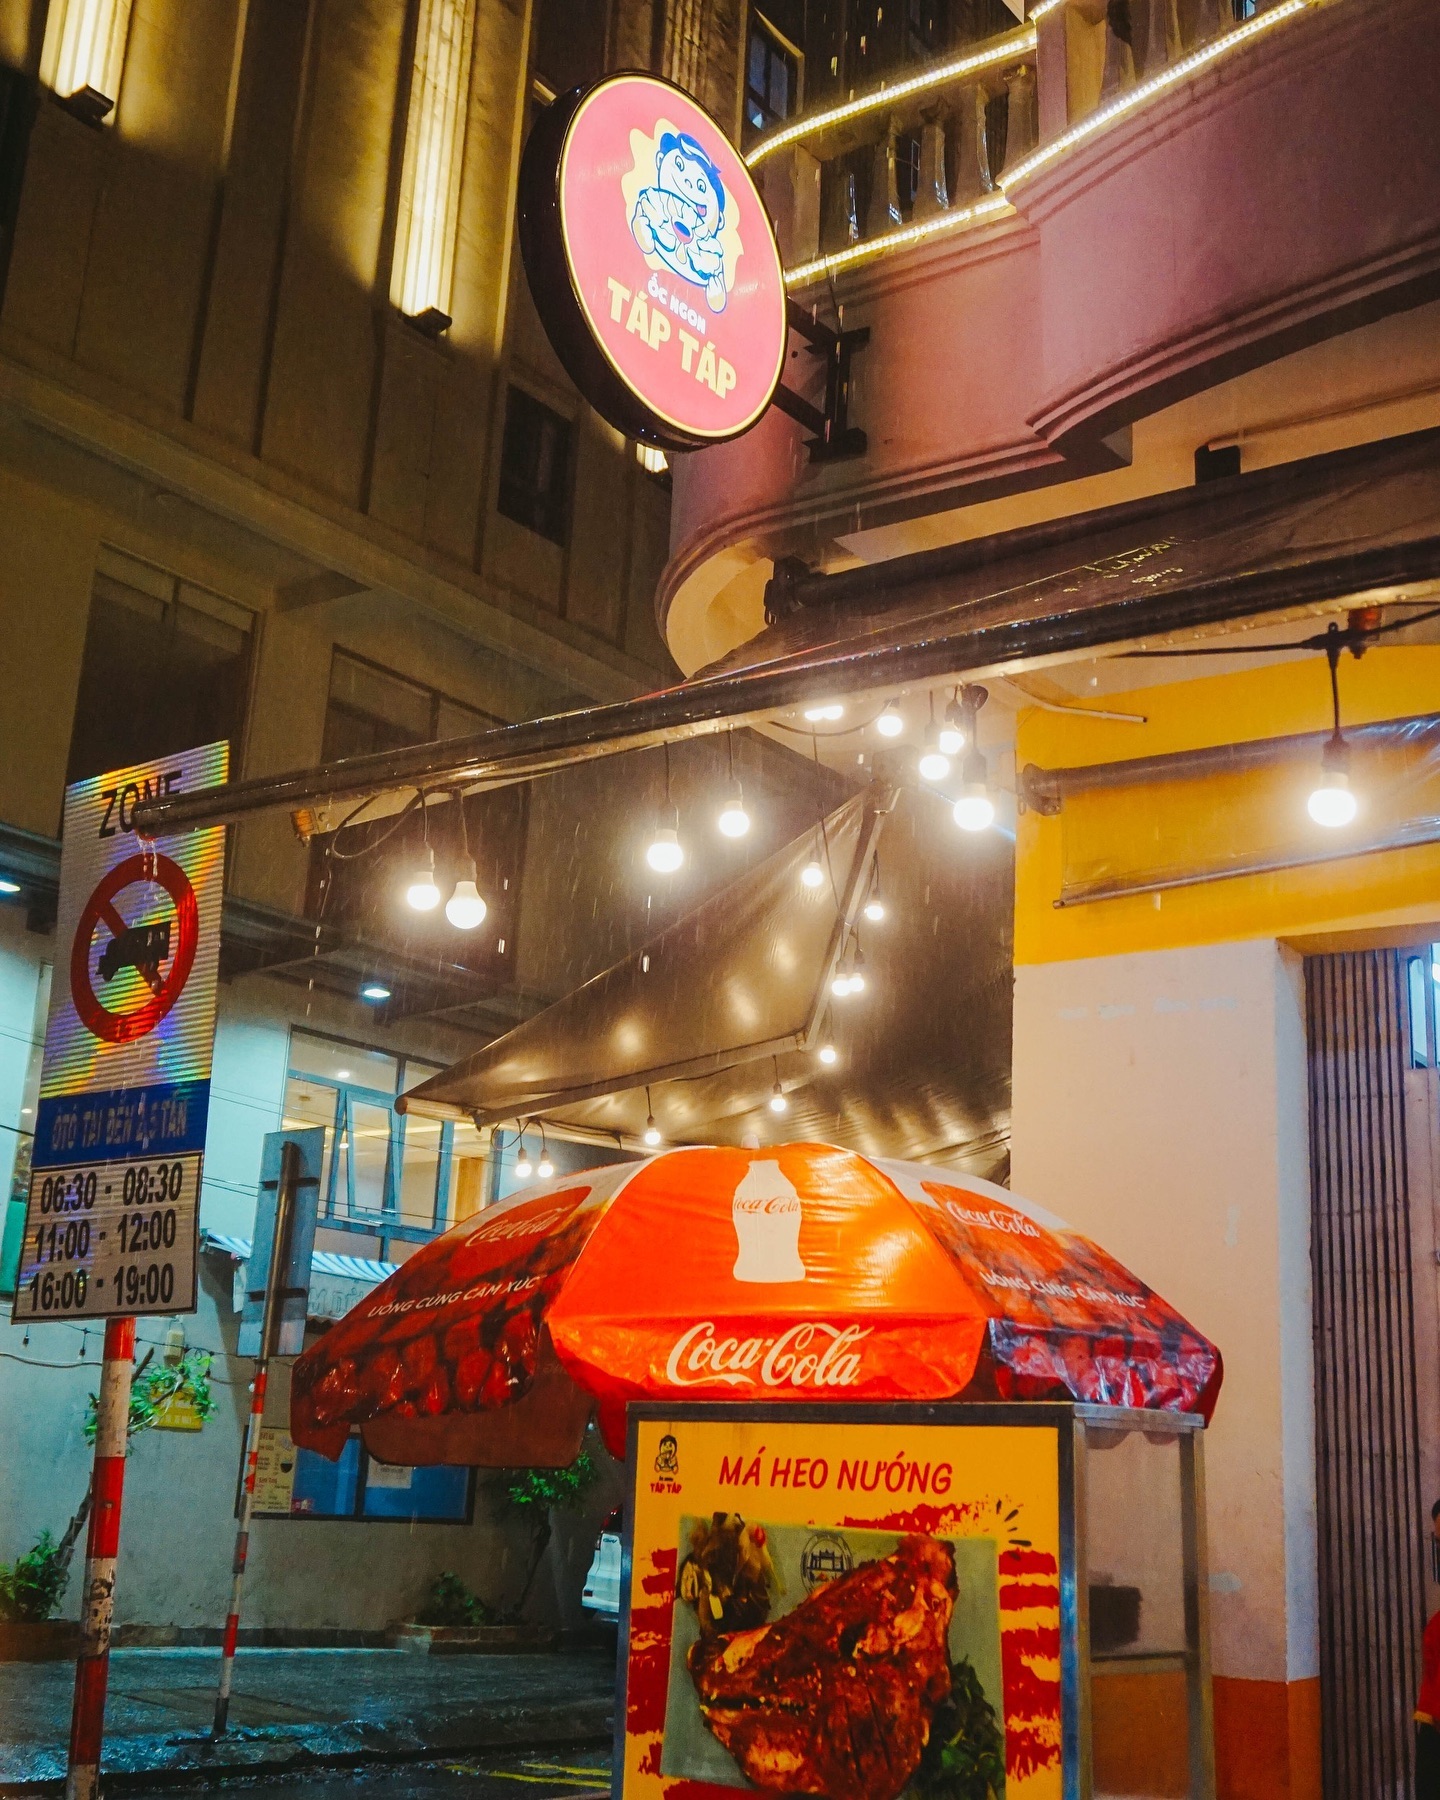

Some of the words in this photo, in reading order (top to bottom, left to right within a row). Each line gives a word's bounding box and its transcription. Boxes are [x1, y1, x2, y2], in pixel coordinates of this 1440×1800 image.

[607, 276, 671, 352] TÁP
[679, 328, 737, 400] TÁP
[670, 294, 706, 335] NGON
[41, 1172, 97, 1214] 06:30
[123, 1162, 182, 1206] 08:30
[35, 1219, 90, 1263] 11:00
[117, 1209, 176, 1253] 12:00
[946, 1201, 1040, 1238] Coca-Cola
[30, 1269, 87, 1311] 16:00
[114, 1263, 174, 1306] 19:00
[666, 1321, 875, 1386] Coca-Cola
[719, 1446, 766, 1486] MÁ
[770, 1457, 828, 1489] HEO
[837, 1450, 953, 1494] NƯỚNG
